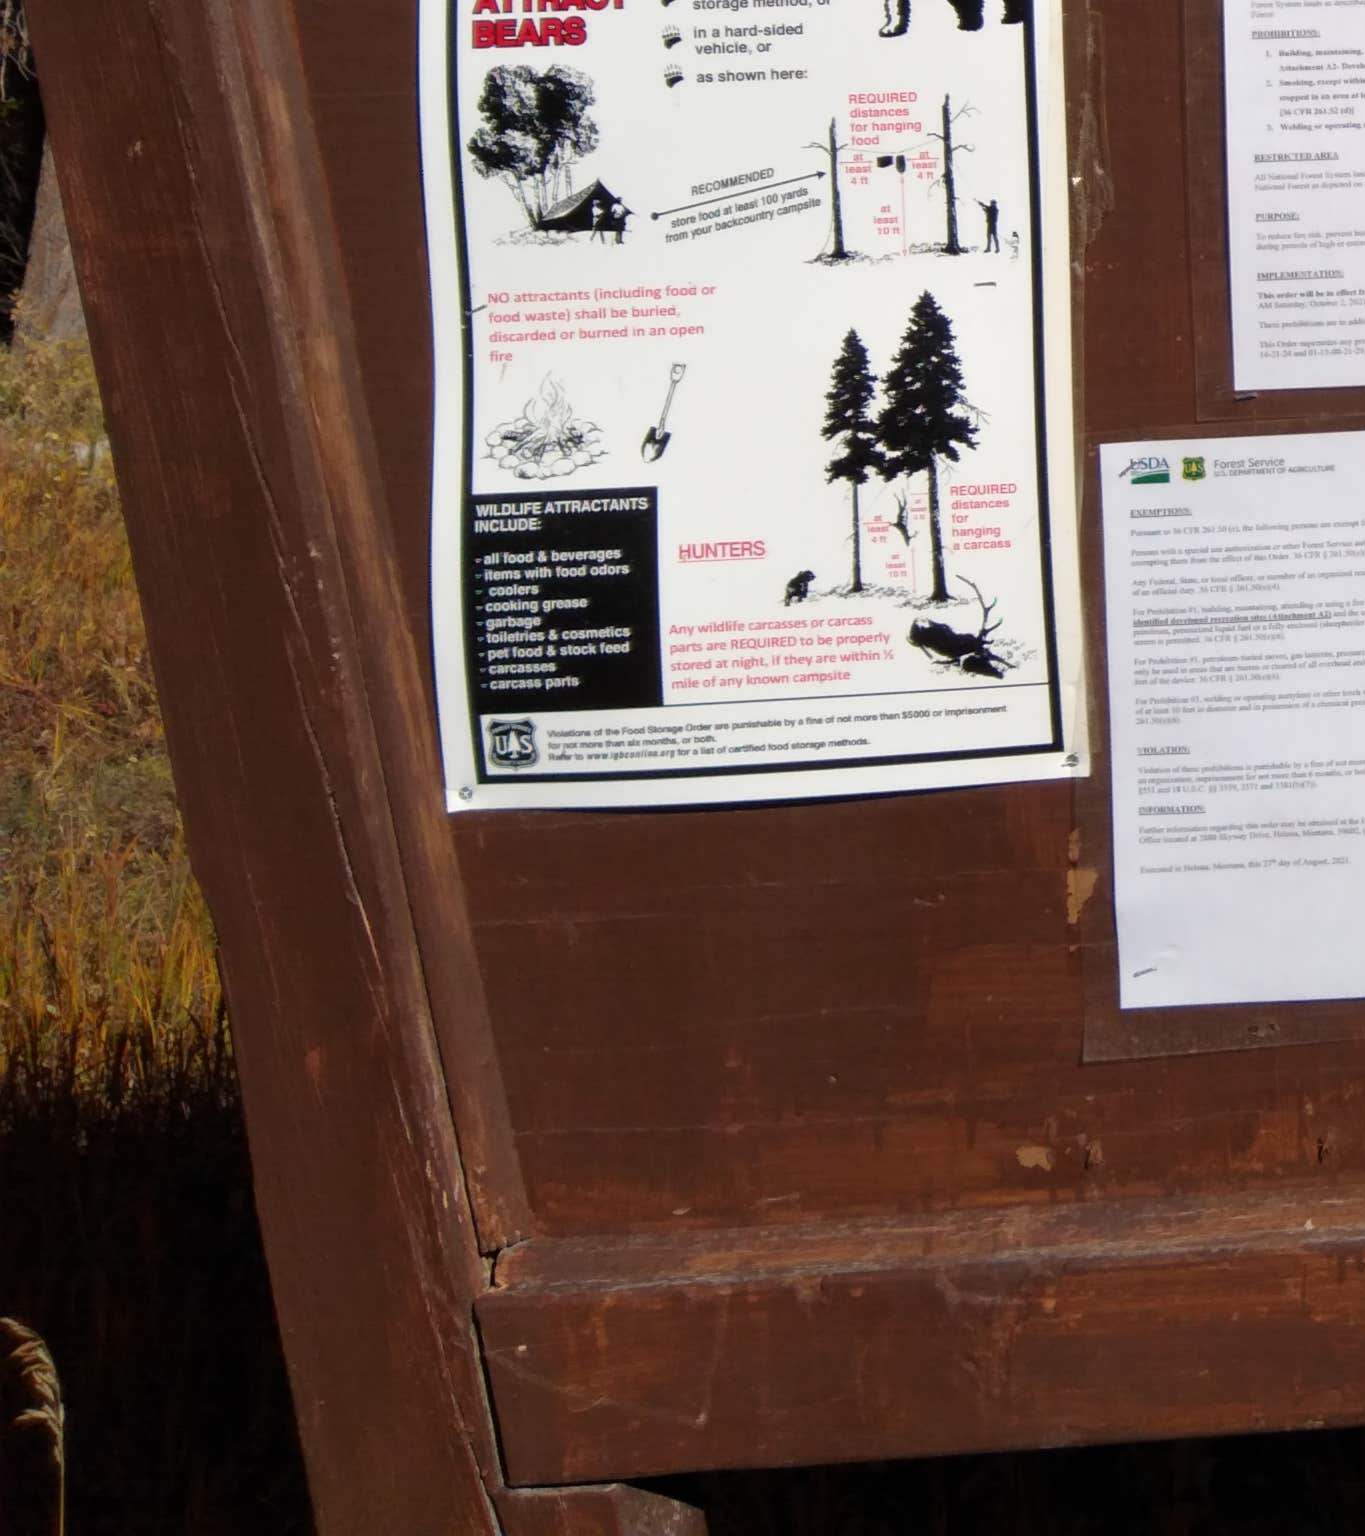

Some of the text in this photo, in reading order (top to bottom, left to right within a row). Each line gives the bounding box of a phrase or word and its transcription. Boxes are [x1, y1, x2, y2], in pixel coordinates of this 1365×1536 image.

[472, 16, 587, 49] BEARS
[697, 73, 714, 83] as
[718, 71, 766, 82] shown
[849, 92, 917, 104] REQUIRED
[691, 168, 774, 196] RECOMMENDED
[487, 292, 510, 304] NO
[514, 291, 590, 303] attractants
[665, 286, 697, 296] food
[701, 287, 716, 295] or
[1214, 458, 1285, 469] Forest Service
[476, 497, 649, 517] WILDLIFE ATTRACTANTS
[475, 518, 541, 533] INCLUDE:
[484, 549, 621, 565] all food & beverages
[680, 541, 766, 560] HUNTERS
